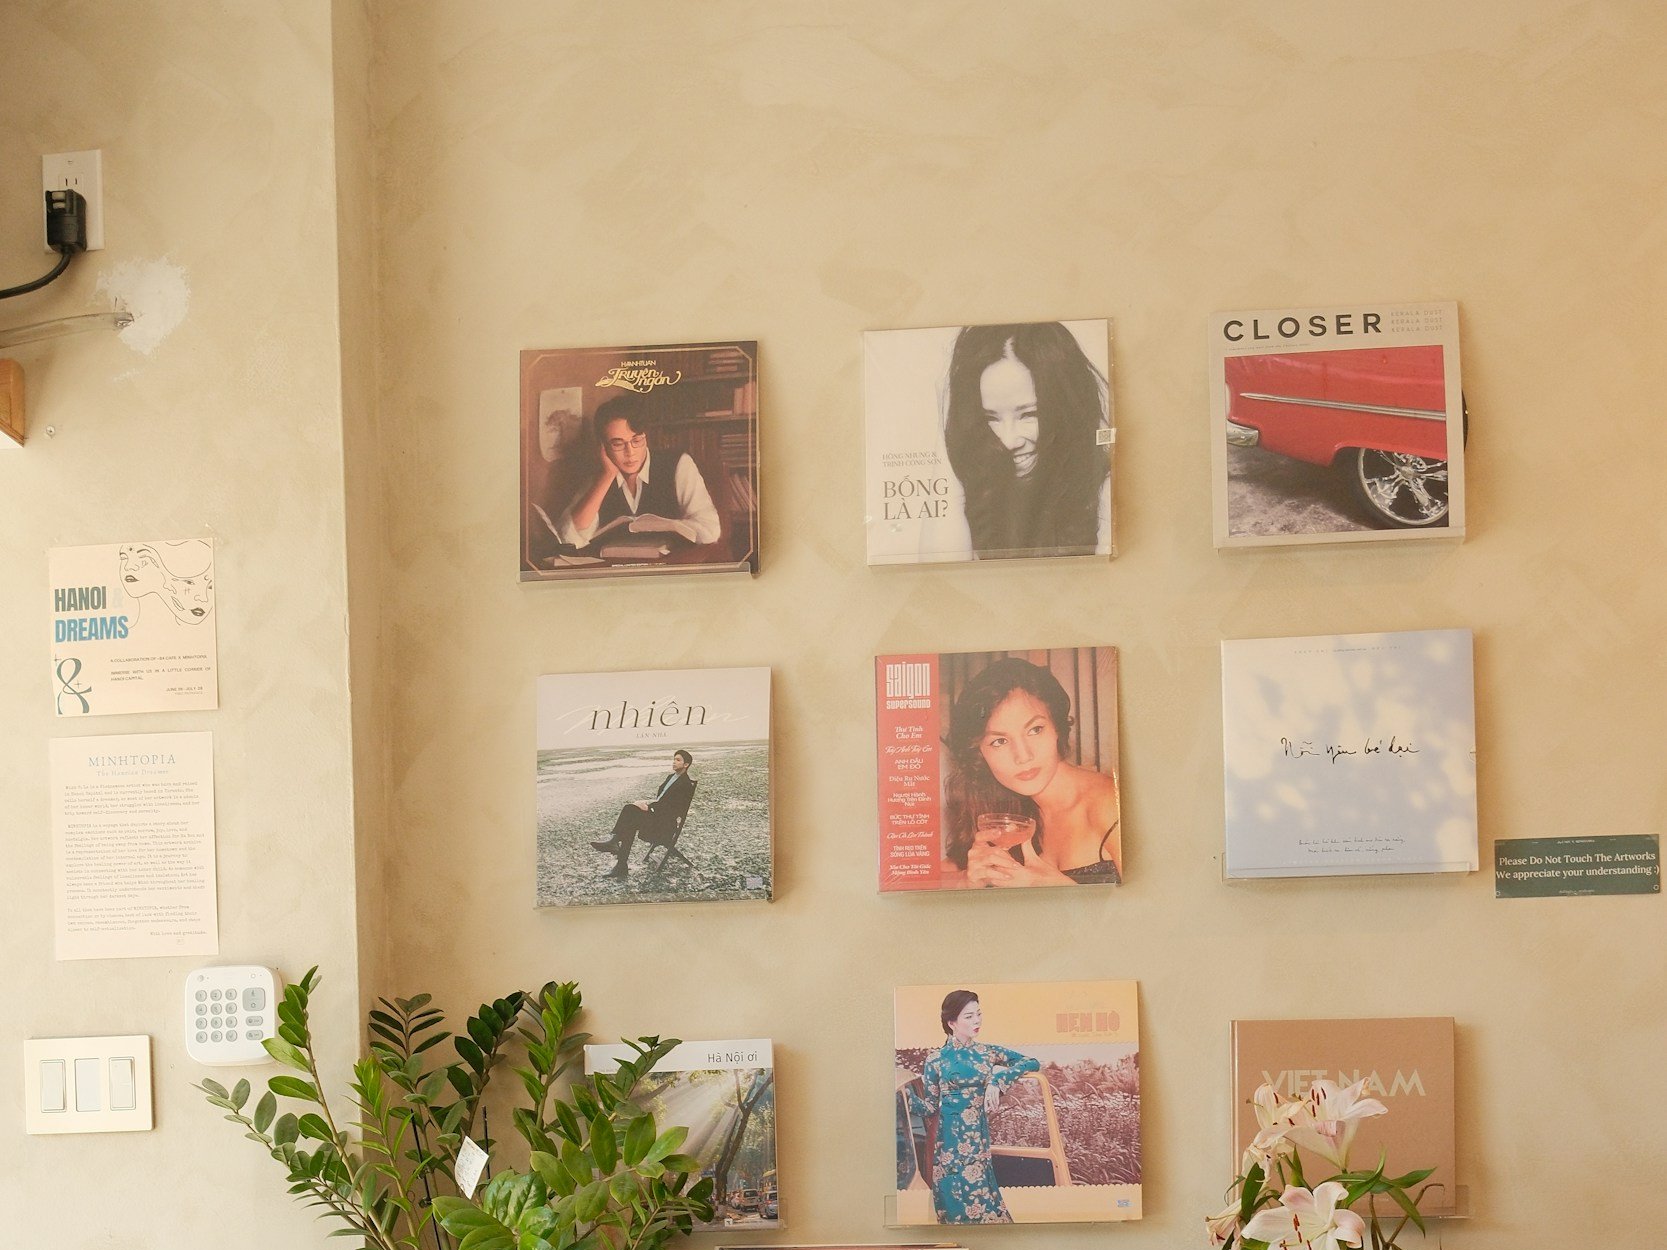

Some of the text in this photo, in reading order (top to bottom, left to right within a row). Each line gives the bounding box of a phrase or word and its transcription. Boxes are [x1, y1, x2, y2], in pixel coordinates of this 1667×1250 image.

[1223, 313, 1382, 342] CLOSER
[883, 475, 949, 498] BỐNG
[883, 497, 949, 520] LÀ AI?
[54, 586, 107, 612] HANOI
[55, 615, 129, 643] DREAMS
[588, 700, 706, 730] nhiên
[88, 754, 176, 767] MINHTOPIA
[1499, 851, 1656, 866] Please Do Not Touch The Artworks
[1496, 870, 1511, 879] We
[1512, 868, 1561, 880] appreciate
[1562, 868, 1584, 879] your
[1586, 865, 1652, 876] understanding
[707, 1050, 758, 1064] Hà Nội ơi
